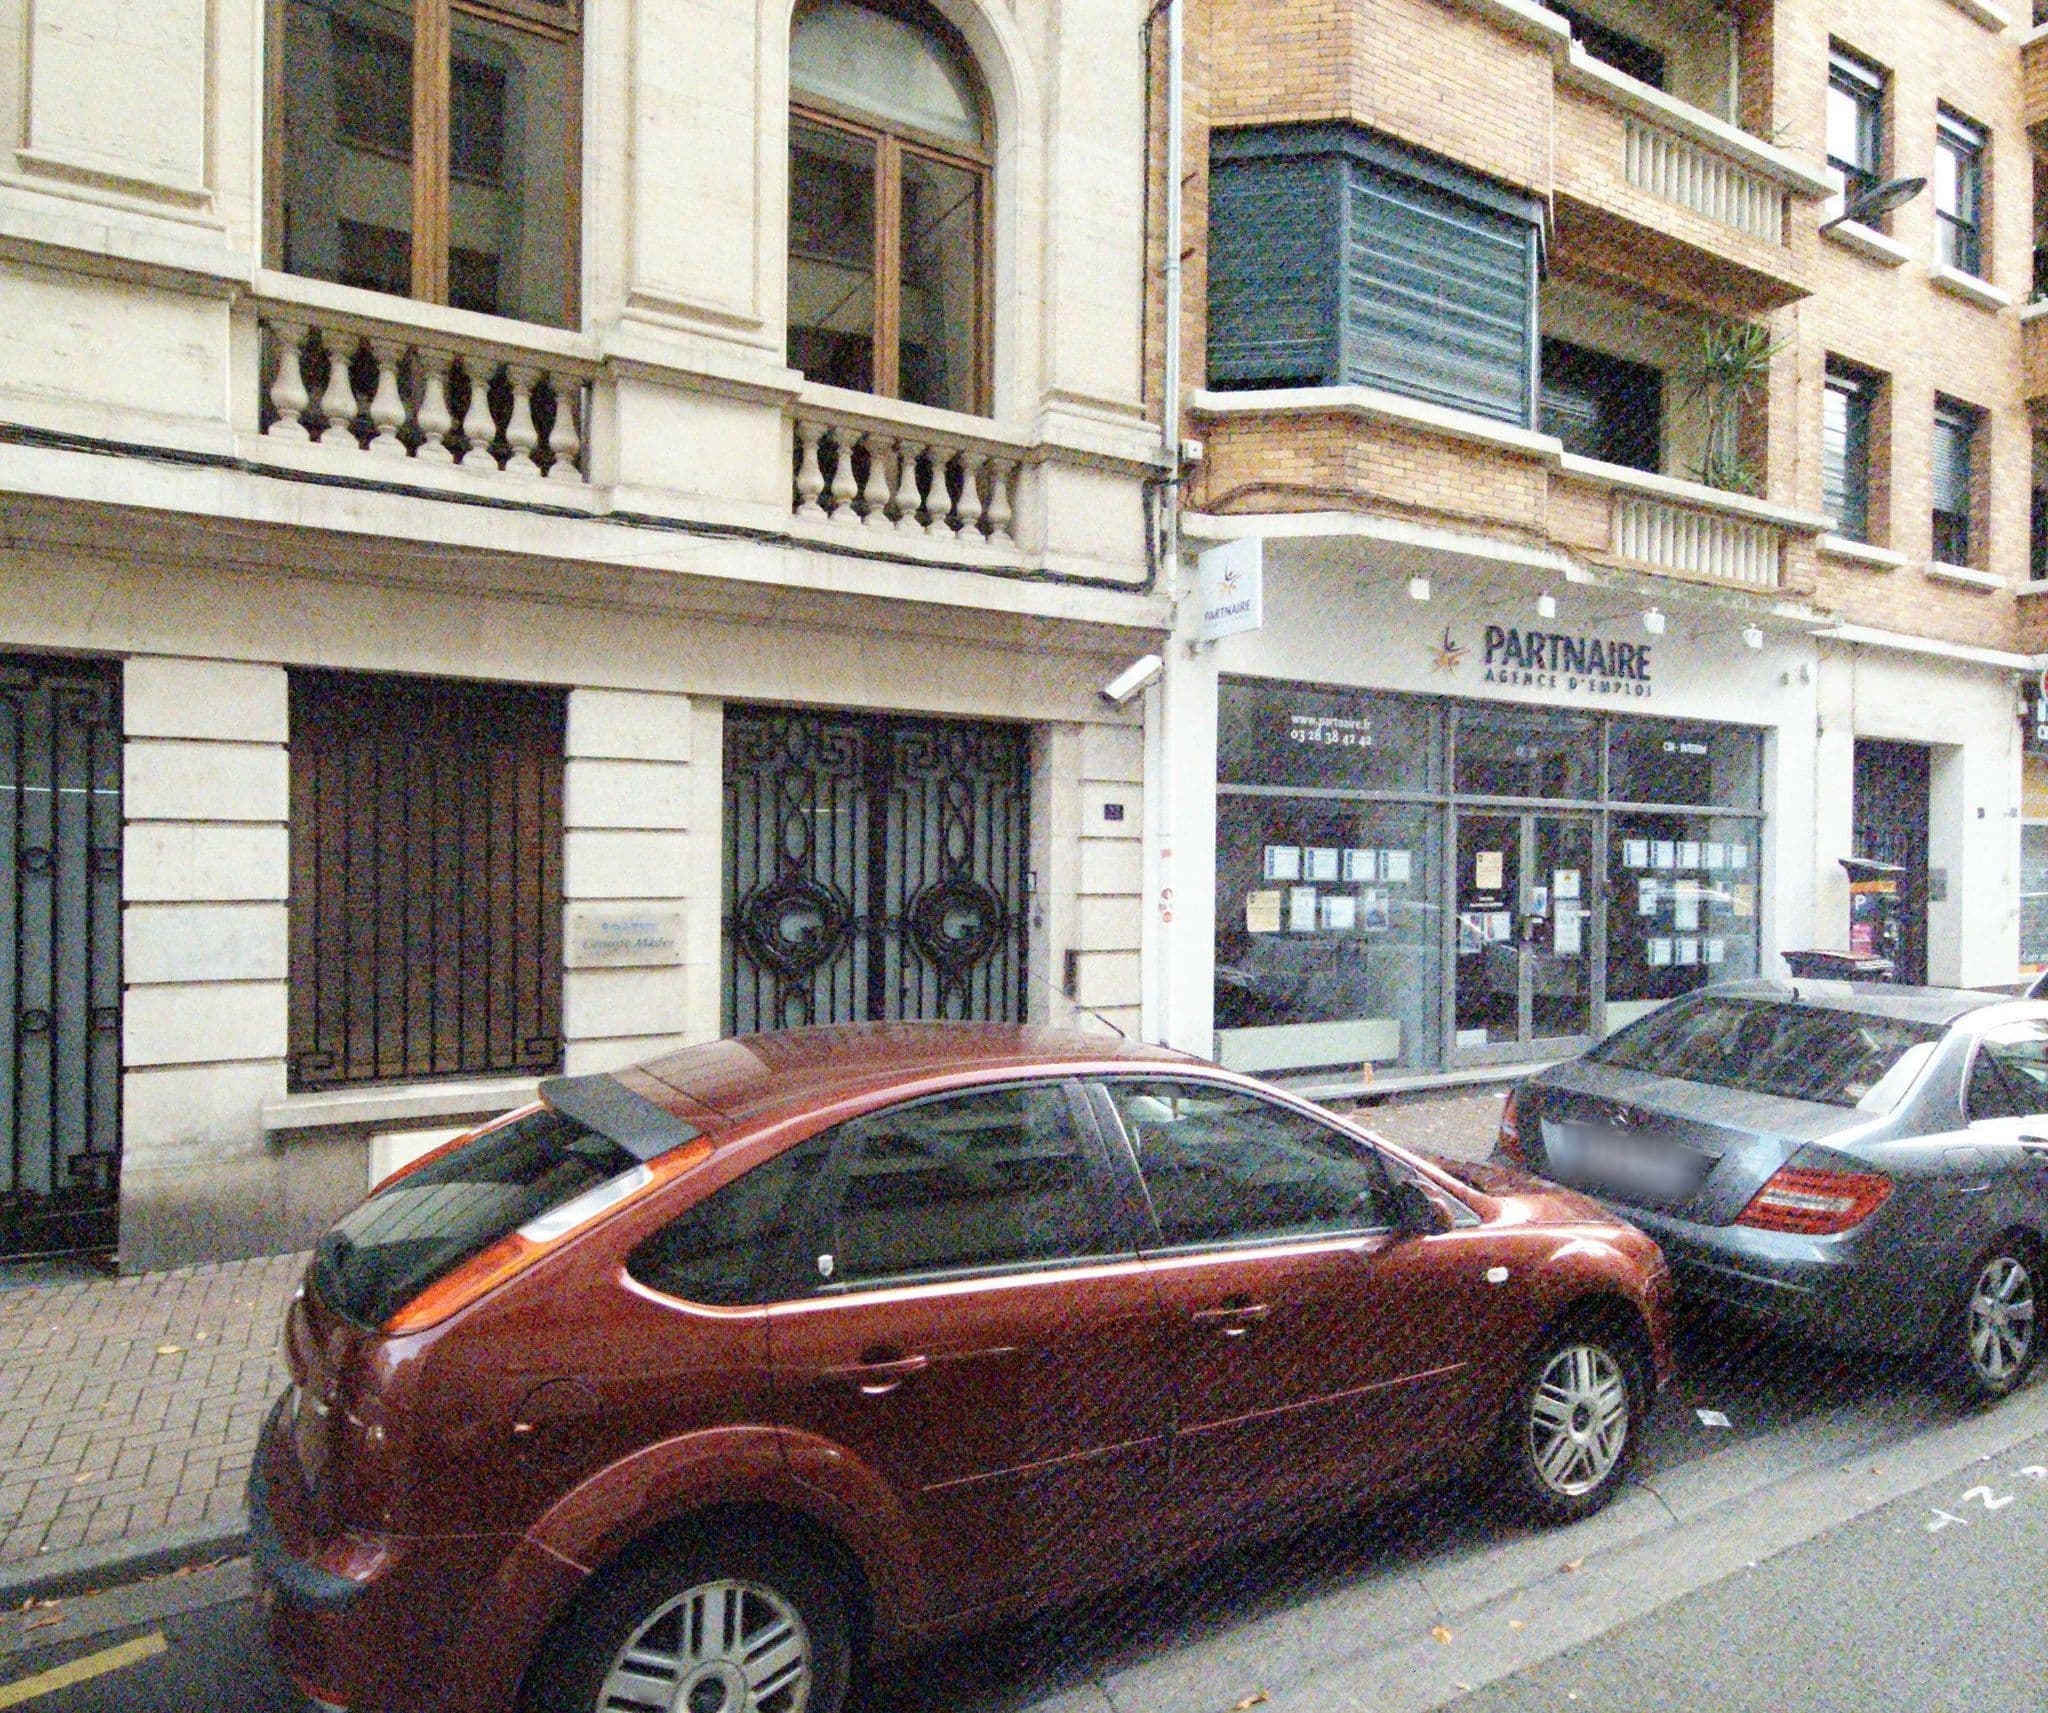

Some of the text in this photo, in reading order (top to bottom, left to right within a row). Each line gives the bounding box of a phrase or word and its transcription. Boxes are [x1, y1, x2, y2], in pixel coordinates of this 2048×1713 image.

[1204, 599, 1250, 621] PARTNAIRE
[1485, 625, 1651, 680] PARTNAIRE
[1485, 668, 1651, 697] AGENCE D'EMPLOI
[1290, 729, 1305, 743] 03
[1325, 729, 1339, 745] 38
[1342, 734, 1356, 747] 42
[1358, 735, 1373, 748] 42
[1855, 894, 1866, 911] P
